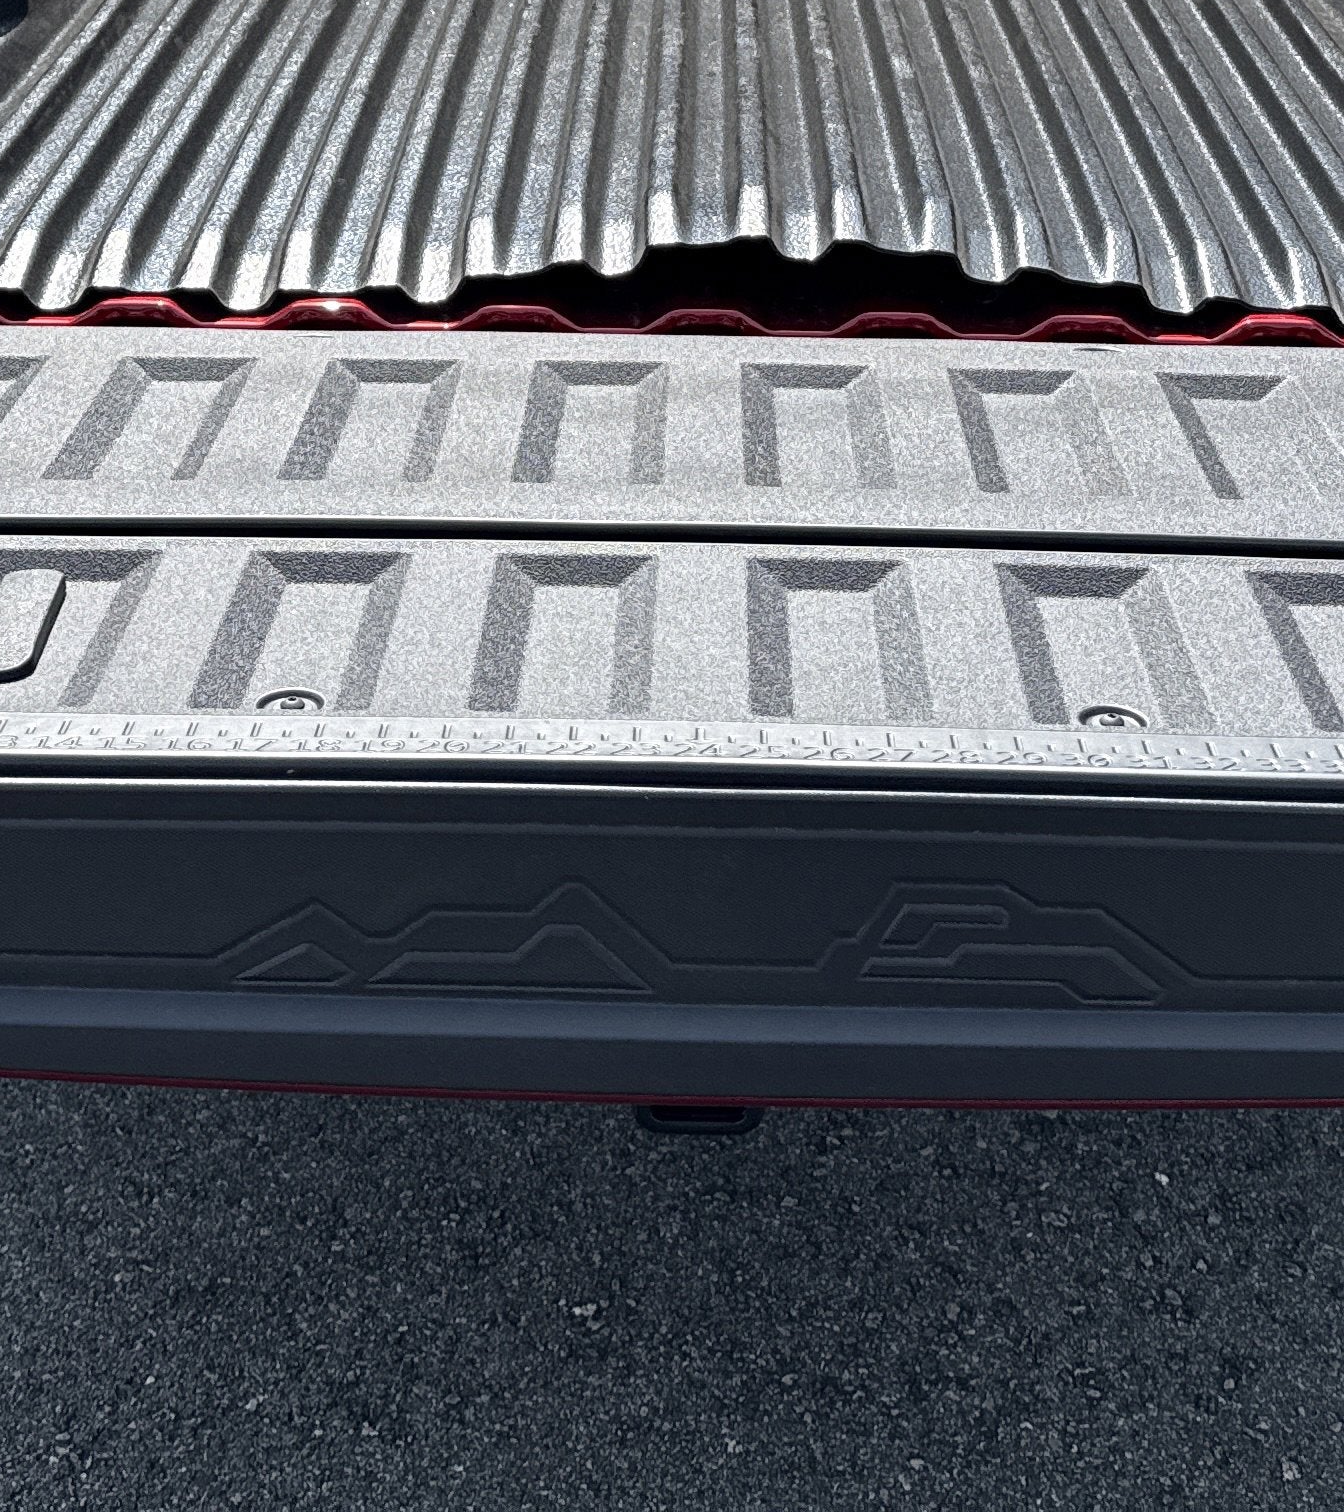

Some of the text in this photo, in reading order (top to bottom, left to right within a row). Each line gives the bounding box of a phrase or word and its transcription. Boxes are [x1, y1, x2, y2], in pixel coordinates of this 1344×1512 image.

[30, 736, 82, 749] 14
[96, 737, 147, 750] 15
[161, 738, 211, 751] 16
[226, 739, 278, 751] 17
[291, 739, 342, 752] 18
[355, 739, 405, 752] 19
[416, 739, 470, 753] 20
[481, 740, 532, 753] 21
[545, 741, 596, 755] 22
[610, 742, 662, 756] 23
[673, 743, 723, 757] 24
[739, 744, 791, 758] 25
[803, 747, 856, 761] 26
[868, 748, 918, 762] 27
[932, 750, 984, 763] 28
[996, 750, 1048, 765] 29
[1061, 753, 1113, 767] 30
[1125, 755, 1177, 769] 31
[1190, 757, 1242, 770] 32
[1255, 758, 1308, 772] 33
